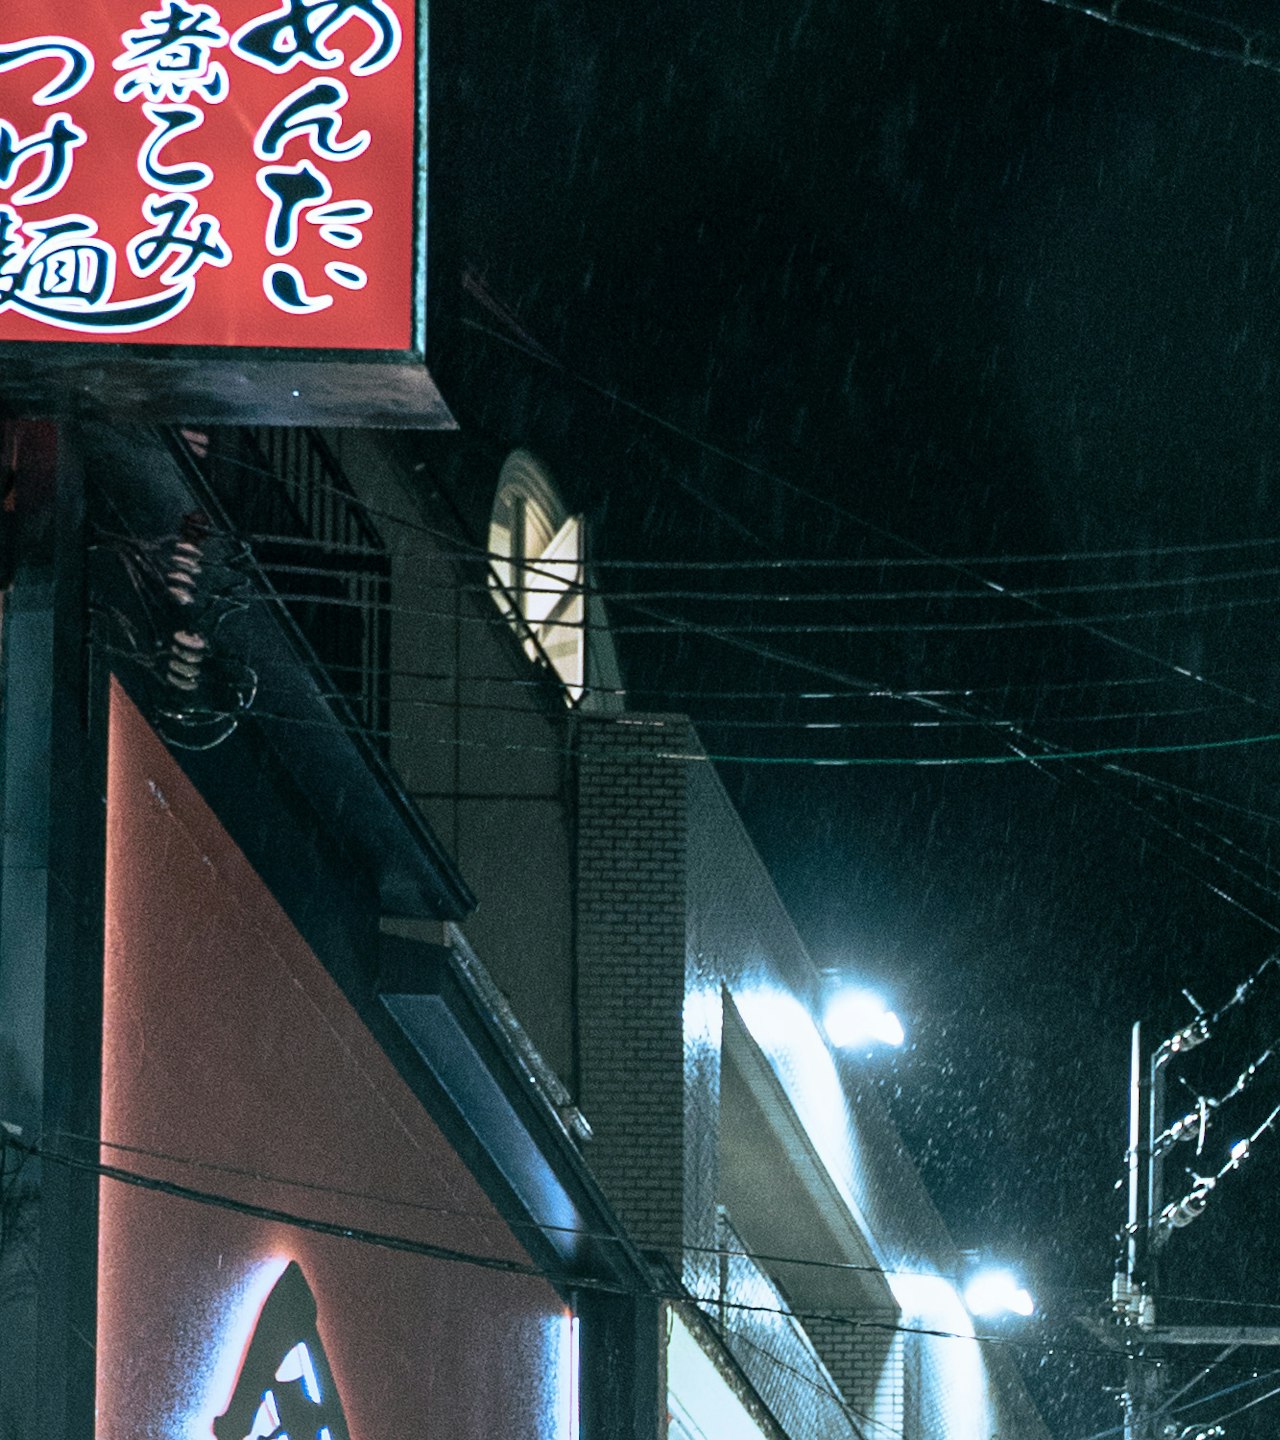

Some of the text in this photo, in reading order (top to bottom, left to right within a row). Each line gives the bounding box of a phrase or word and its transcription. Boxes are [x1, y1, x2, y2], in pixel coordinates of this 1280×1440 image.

[115, 2, 232, 285] 煮こみ
[230, 0, 400, 314] めんたい
